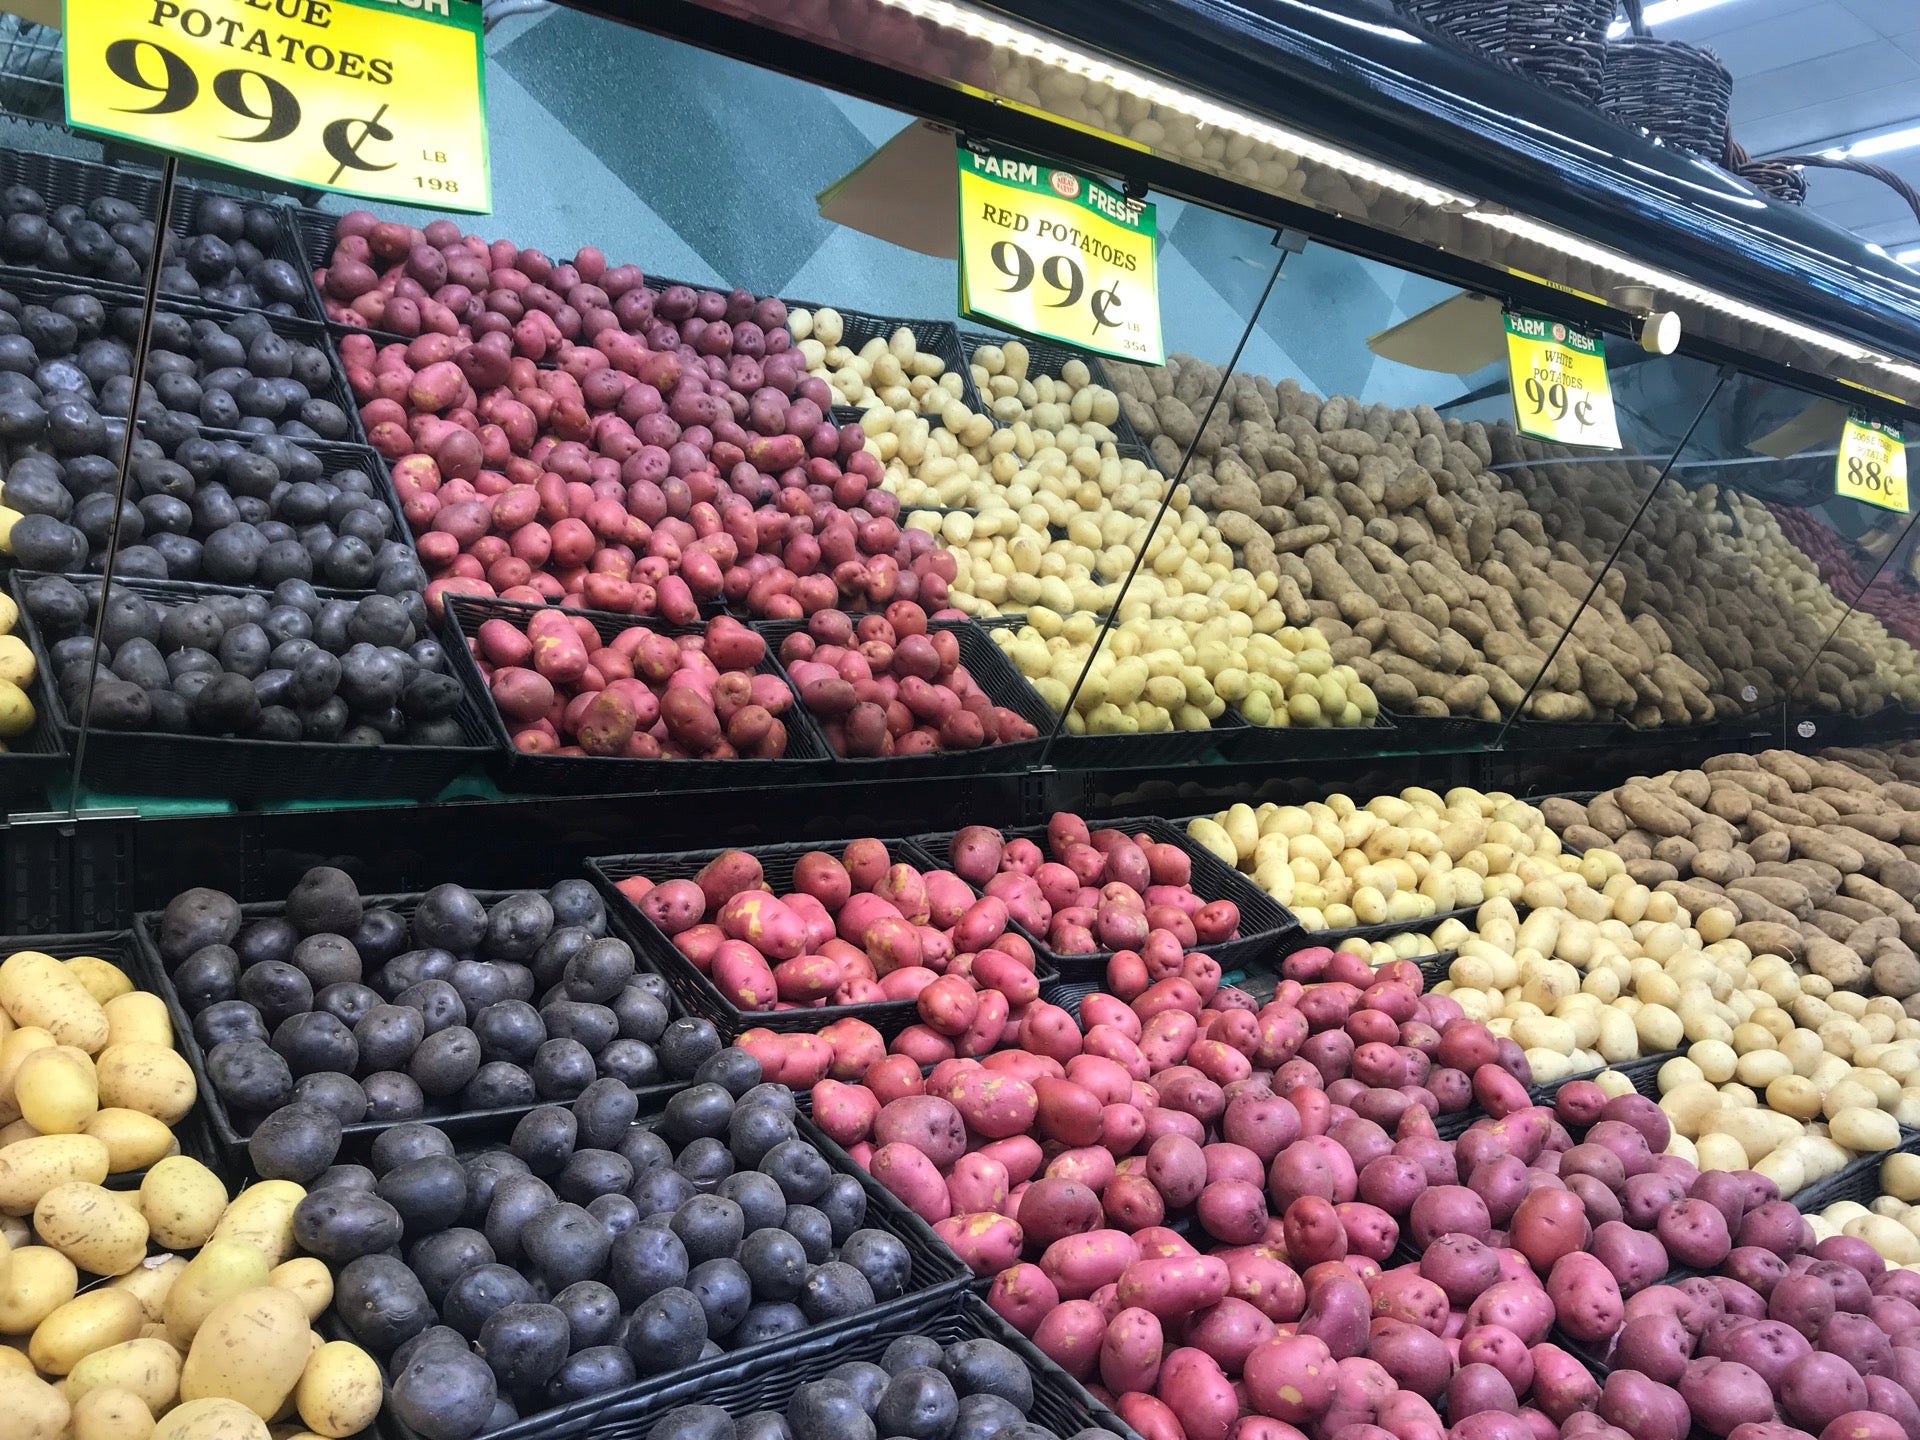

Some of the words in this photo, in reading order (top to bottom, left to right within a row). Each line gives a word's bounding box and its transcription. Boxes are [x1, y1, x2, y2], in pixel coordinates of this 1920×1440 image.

[148, 0, 394, 85] POTATOES
[422, 149, 447, 164] LB
[412, 176, 459, 193] 198
[973, 154, 1037, 185] FARM
[1088, 184, 1139, 226] FRESH
[982, 203, 1029, 232] RED
[1036, 219, 1137, 272] POTATOES
[1511, 318, 1544, 336] FARM
[1568, 329, 1595, 351] FRESH
[1123, 339, 1146, 352] 354
[1545, 350, 1573, 369] WHITE
[1534, 368, 1583, 389] POTATOES
